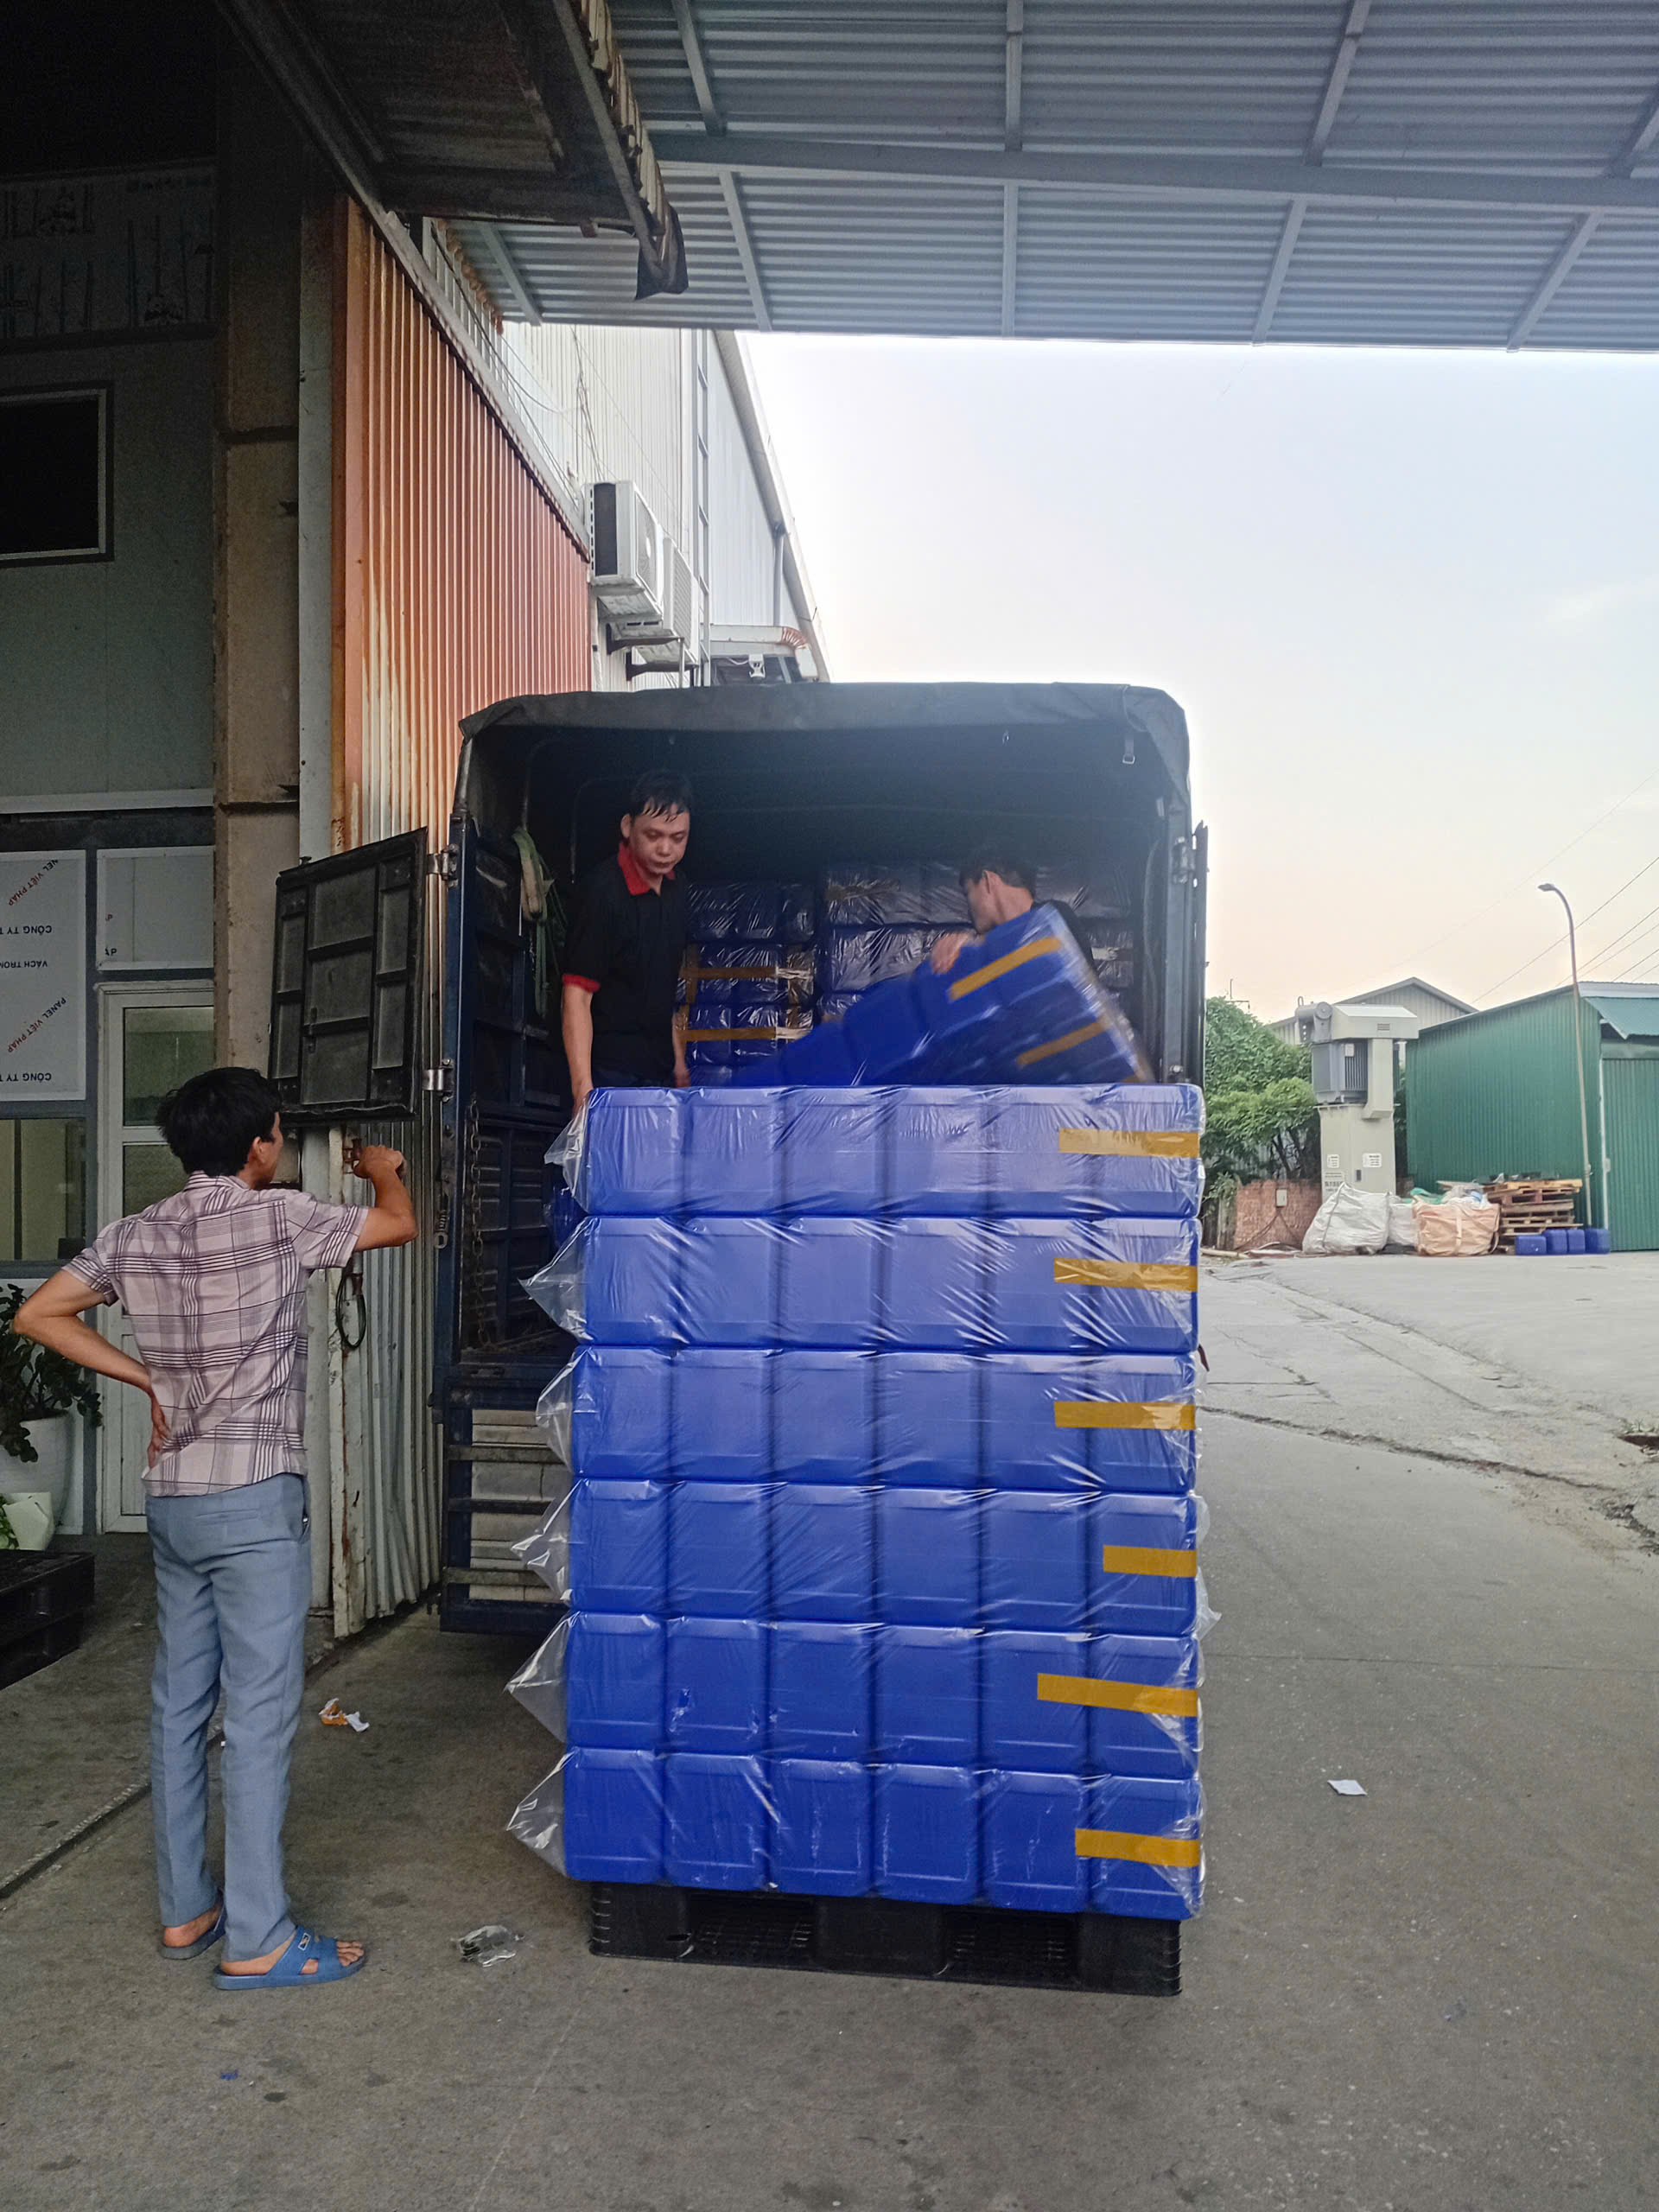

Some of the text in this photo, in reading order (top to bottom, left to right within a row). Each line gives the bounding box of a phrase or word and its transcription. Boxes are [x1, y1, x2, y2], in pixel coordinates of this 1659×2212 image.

[7, 926, 19, 935] TY
[22, 925, 53, 936] CÔNG
[24, 960, 48, 969] VÁCH
[41, 997, 67, 1019] PANEL
[6, 1073, 18, 1082] TY
[22, 1072, 52, 1083] CÔNG
